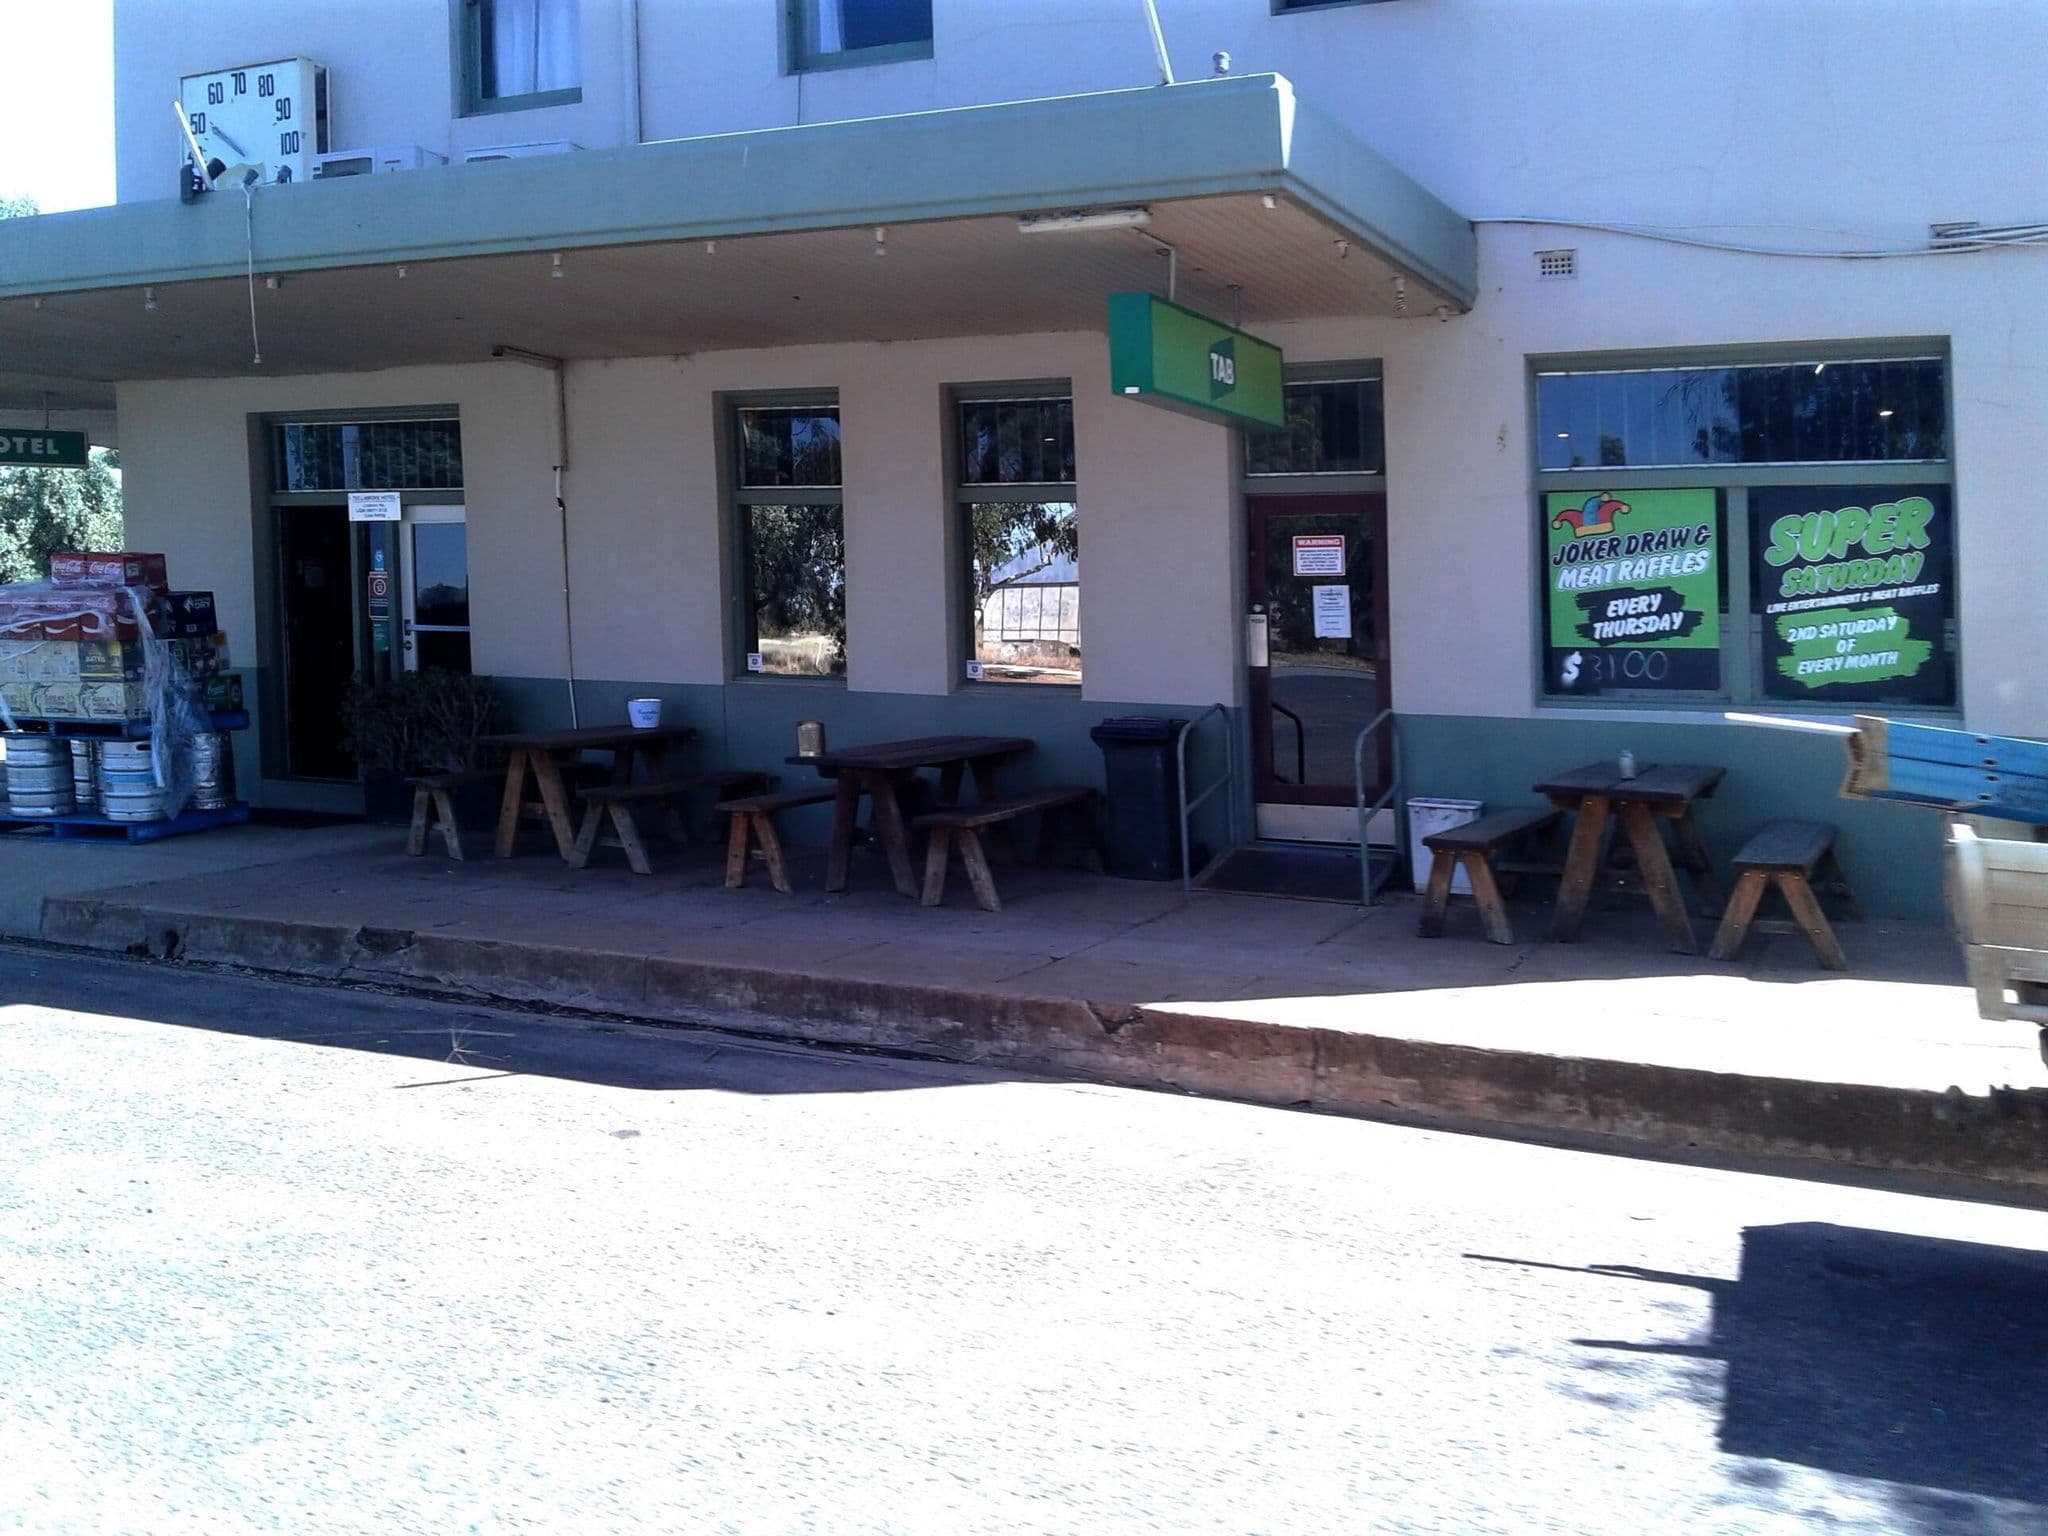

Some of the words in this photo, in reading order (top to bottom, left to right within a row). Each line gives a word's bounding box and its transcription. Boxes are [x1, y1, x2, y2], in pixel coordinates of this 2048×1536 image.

[208, 82, 223, 105] 60
[231, 72, 246, 96] 70
[258, 74, 274, 98] 80
[275, 97, 291, 122] 90
[190, 112, 206, 135] 50
[281, 131, 300, 156] 100
[1210, 352, 1235, 385] TAB
[1764, 496, 1935, 567] SUPER
[1553, 536, 1622, 566] JOKER
[1624, 526, 1691, 555] DRAW
[1694, 523, 1712, 546] &
[1557, 562, 1616, 591] MEAT
[1617, 549, 1711, 582] RAFFLES
[1779, 551, 1926, 598] SATURDAY
[1606, 593, 1662, 618] EVERY
[1766, 602, 1788, 614] LIVE
[1788, 593, 1862, 611] ENTERTAINMENT
[1862, 592, 1870, 602] &
[1870, 588, 1898, 601] MEAT
[1898, 583, 1941, 597] RAFFLES
[1593, 611, 1684, 640] THURSDAY
[1787, 626, 1818, 643] 2ND
[1819, 616, 1899, 639] SATURDAY
[1836, 639, 1857, 653] OF
[1796, 657, 1844, 675] EVERY
[1844, 651, 1899, 669] MONTH
